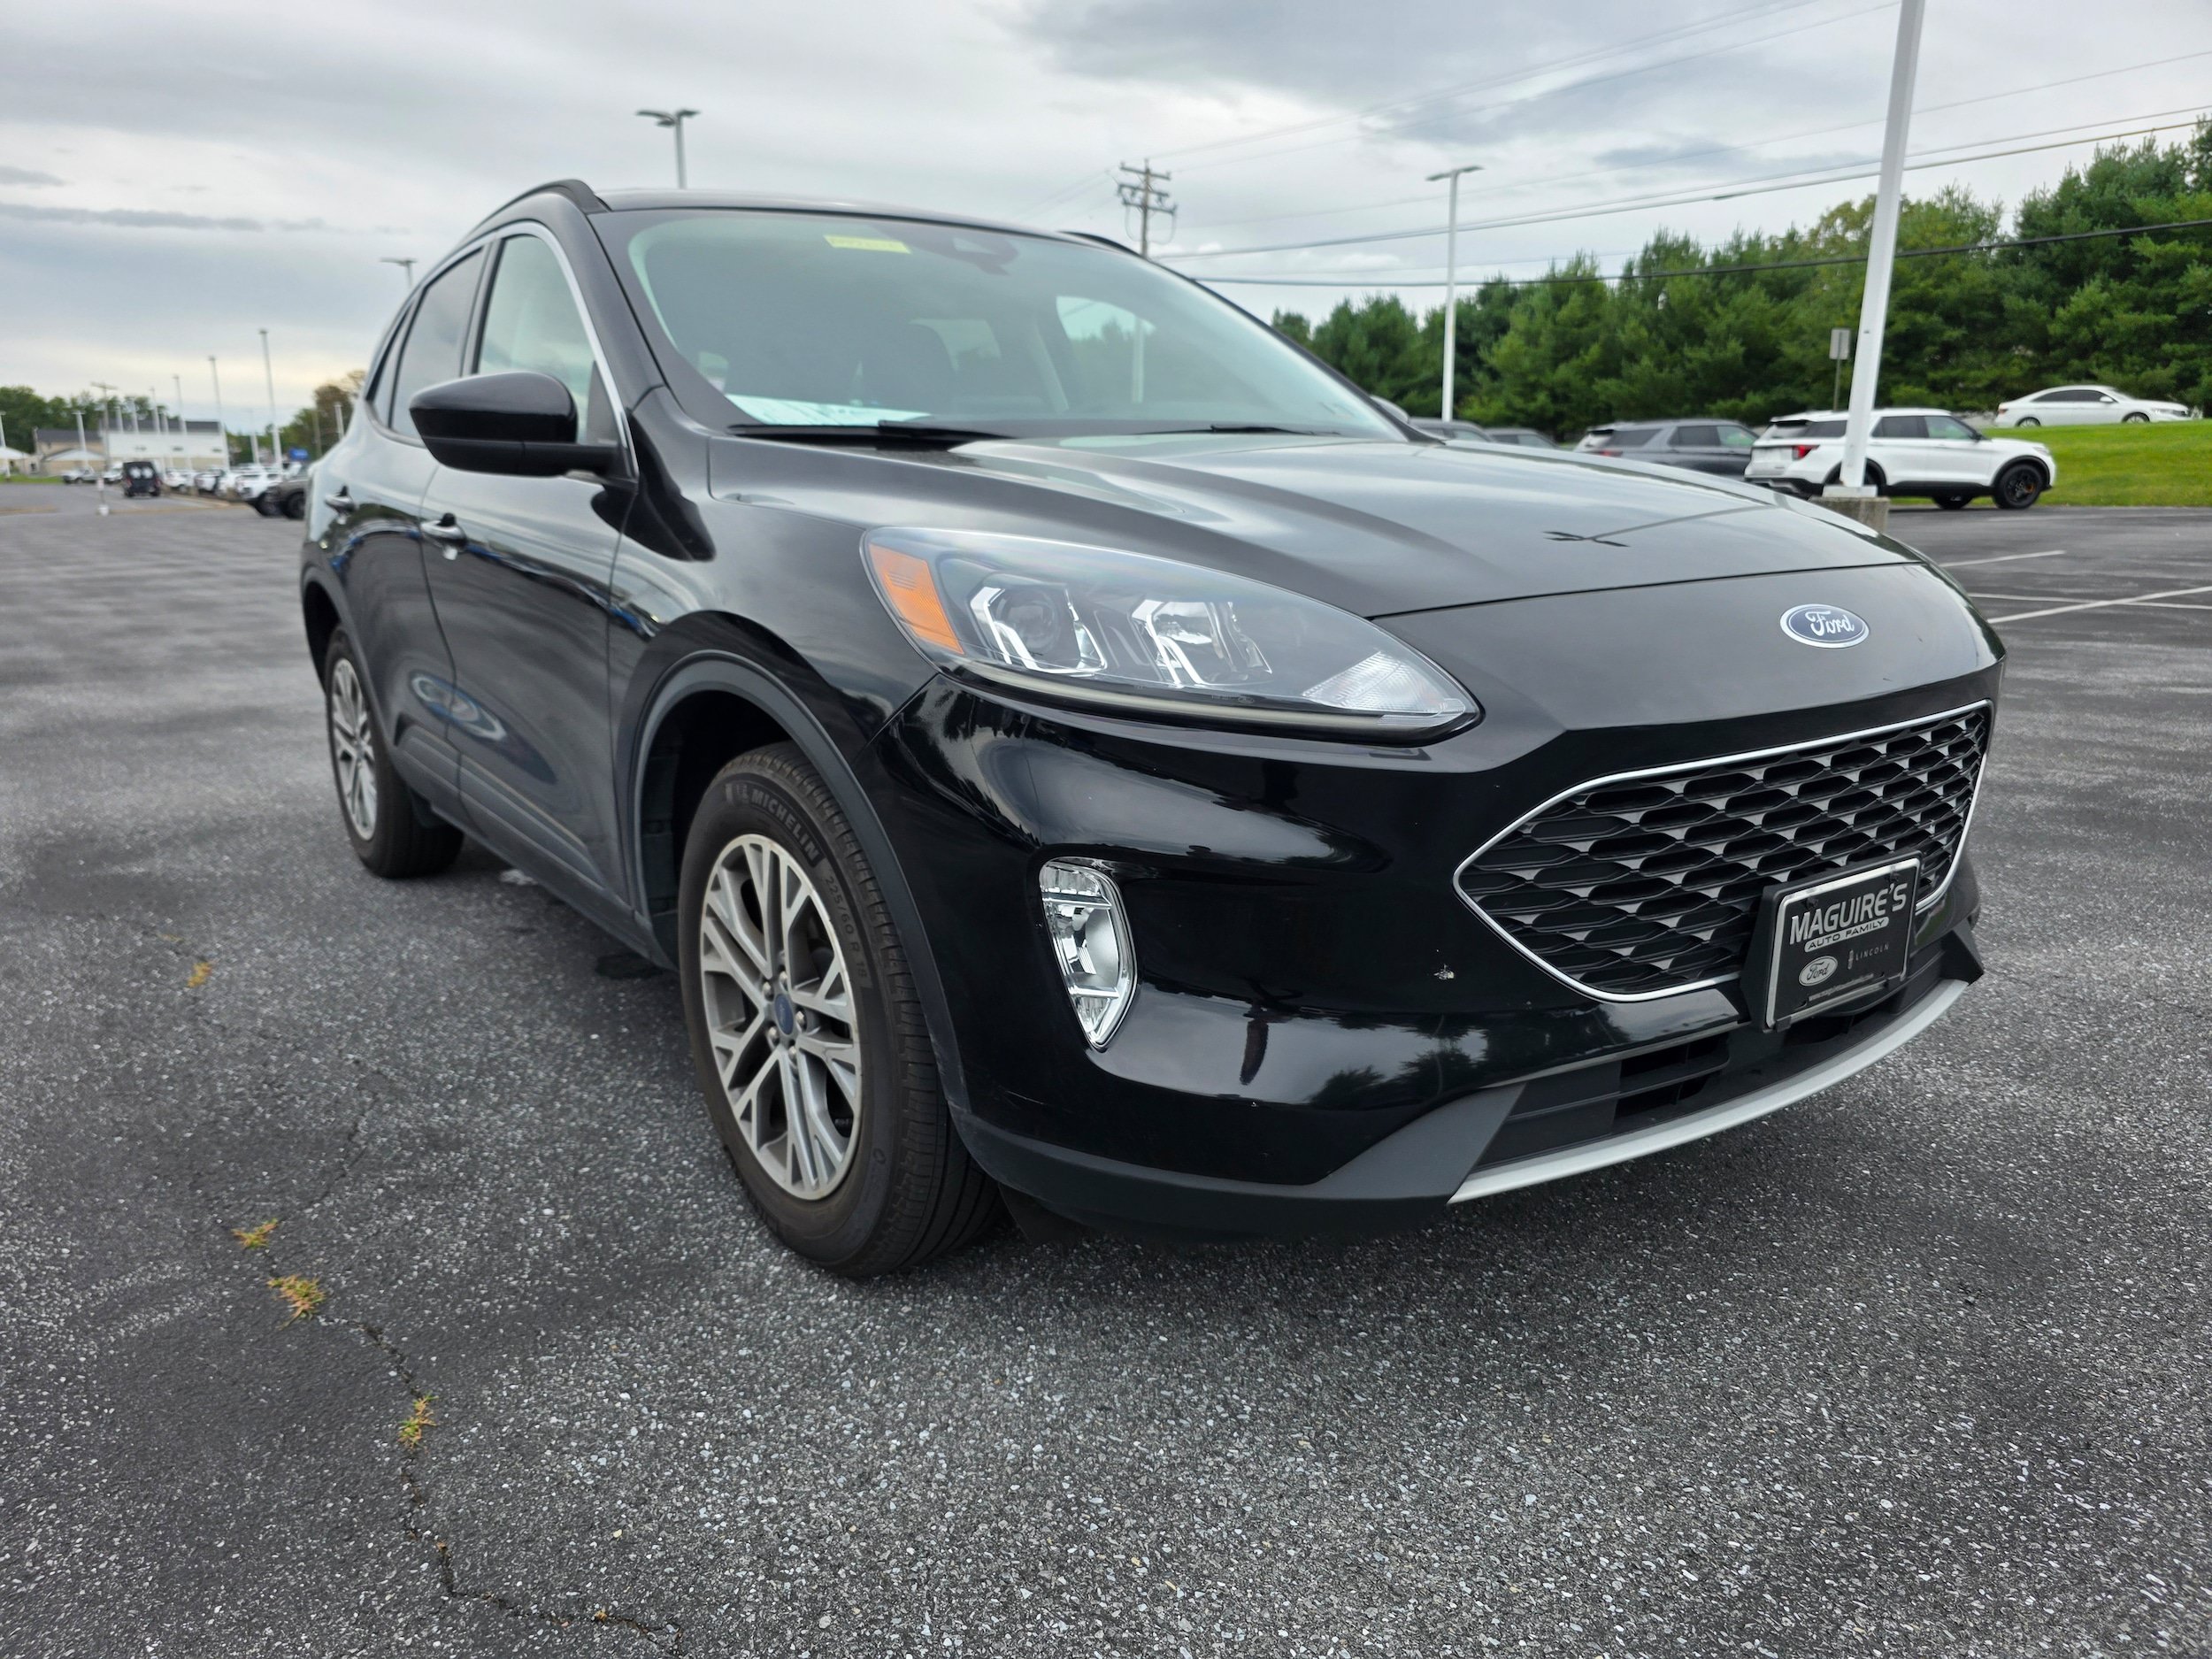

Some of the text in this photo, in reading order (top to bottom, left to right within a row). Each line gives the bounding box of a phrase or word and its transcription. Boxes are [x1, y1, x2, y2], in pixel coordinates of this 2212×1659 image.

[1805, 611, 1855, 636] Ford
[751, 788, 819, 861] MICHELIN
[825, 876, 854, 934] 225/60
[849, 941, 860, 952] R
[1789, 883, 1908, 945] MAGUIRE'S
[1808, 919, 1885, 949] AUTO FAMILY
[1855, 942, 1889, 961] LINCOLN
[1807, 961, 1830, 980] Ford
